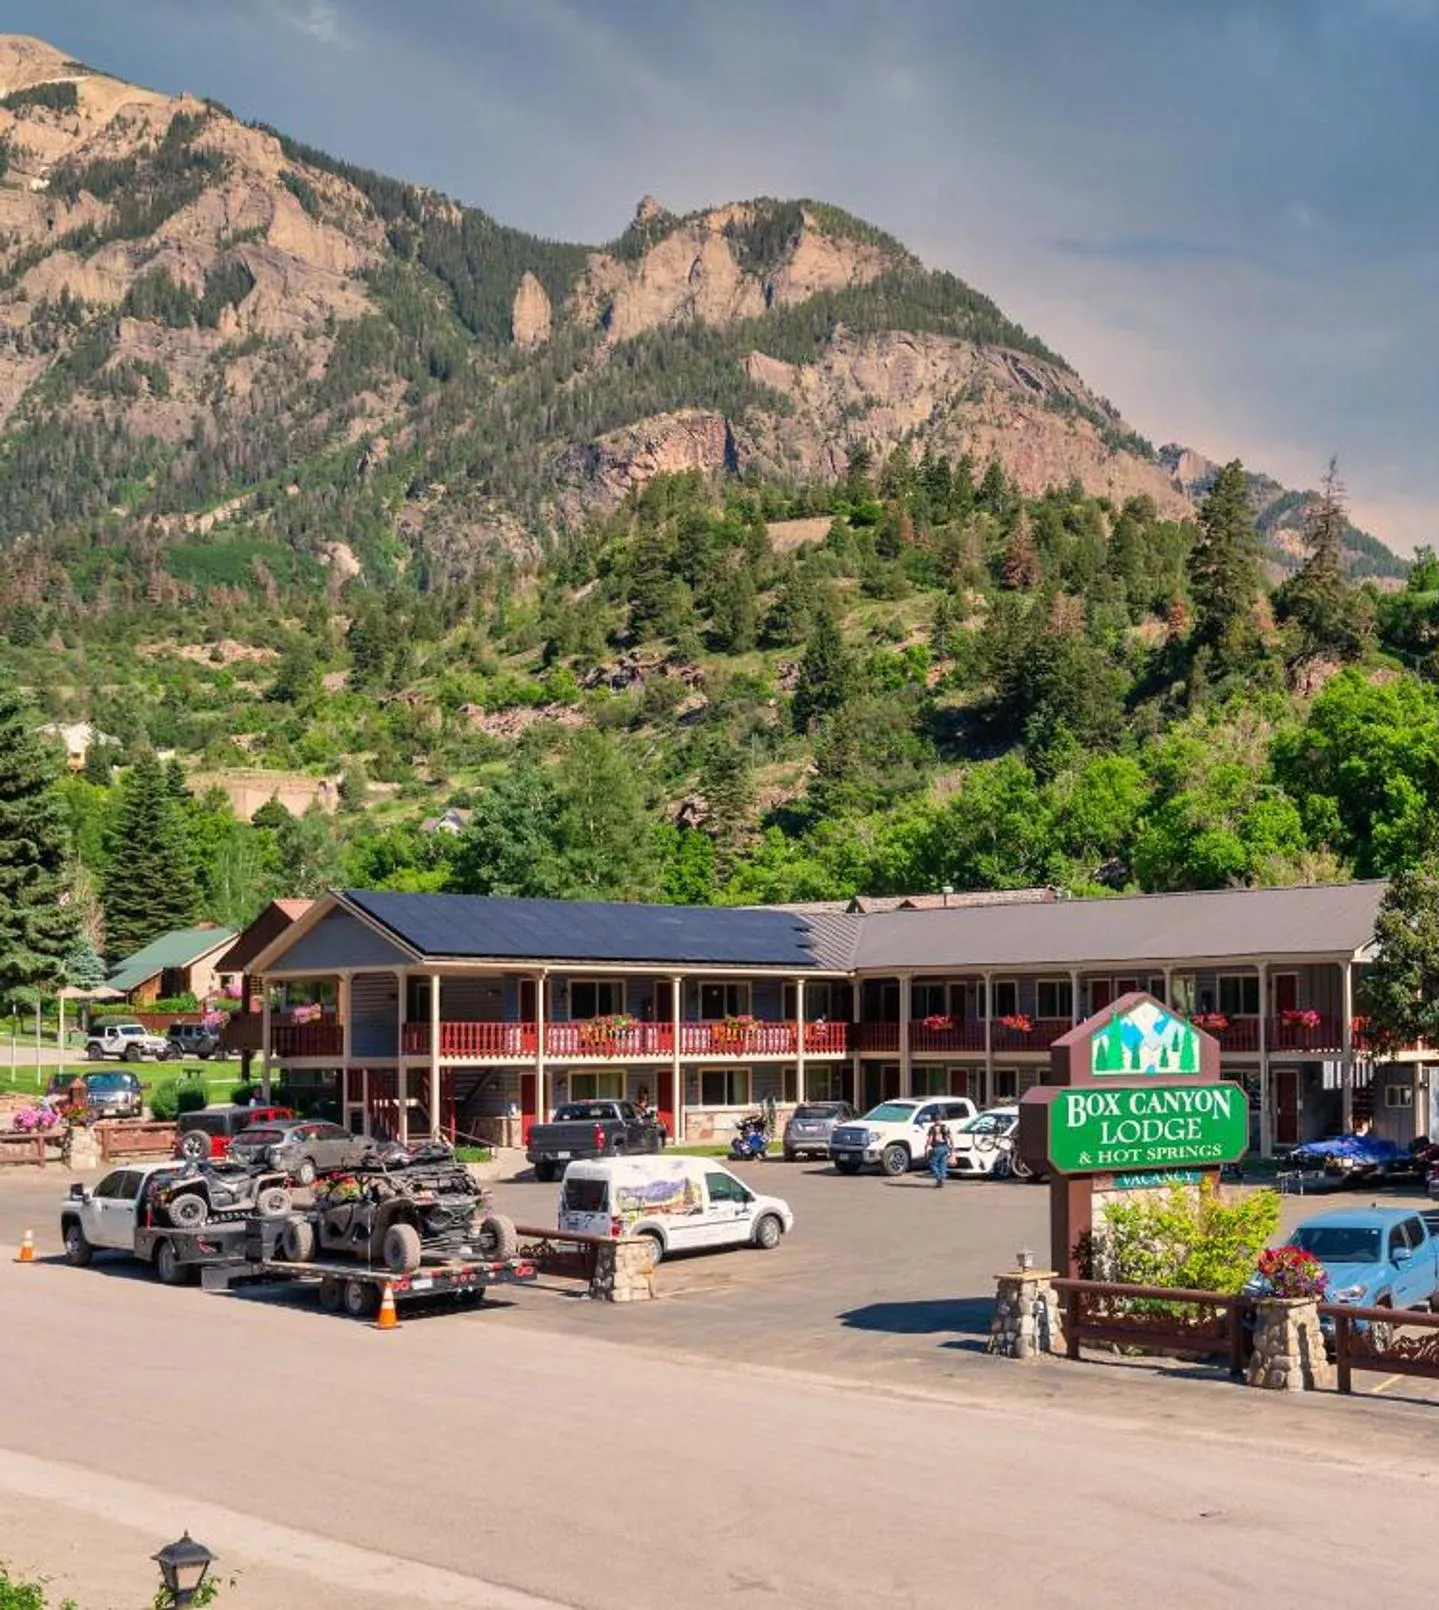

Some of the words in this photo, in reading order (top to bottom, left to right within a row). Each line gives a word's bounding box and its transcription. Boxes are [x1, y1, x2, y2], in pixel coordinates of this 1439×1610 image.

[1068, 1093, 1121, 1127] BOX
[1130, 1089, 1232, 1119] CANYON
[1101, 1117, 1202, 1144] LODGE
[1079, 1151, 1092, 1164] &
[1098, 1149, 1142, 1164] HOT
[1147, 1144, 1222, 1161] SPRINGS
[1123, 1171, 1193, 1186] VACANCY
